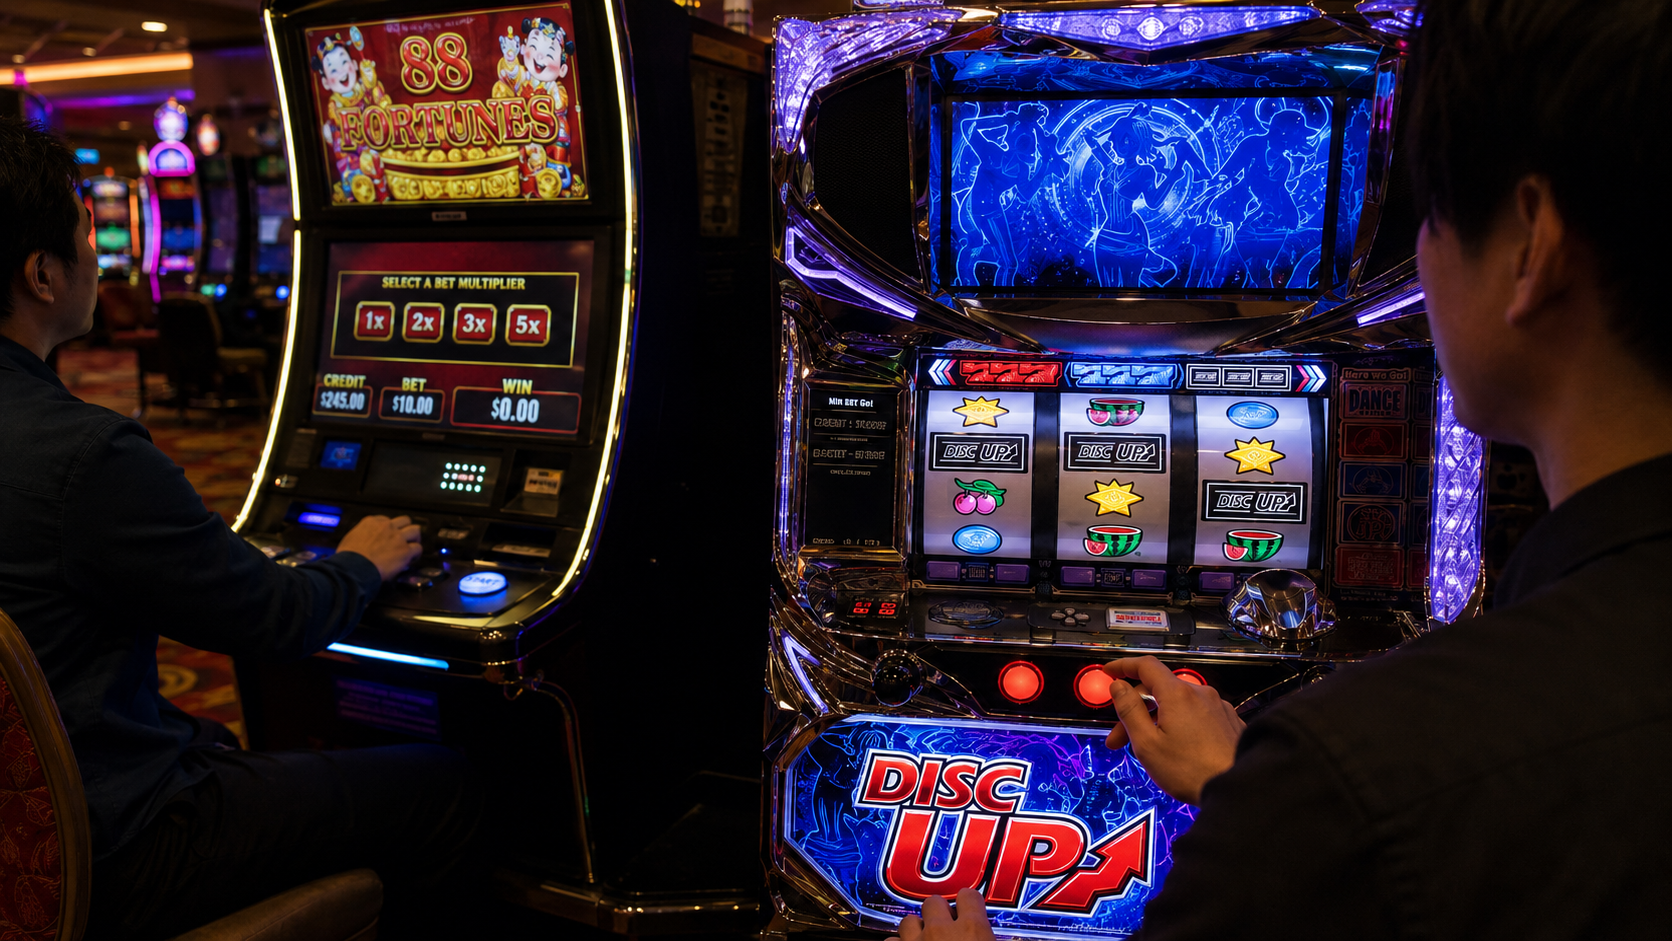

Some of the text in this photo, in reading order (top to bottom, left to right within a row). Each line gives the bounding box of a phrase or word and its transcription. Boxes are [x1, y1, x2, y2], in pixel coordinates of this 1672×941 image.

[400, 32, 473, 95] 88
[338, 94, 559, 151] FORTUNES
[382, 277, 526, 291] SELECT A BET MULTIPLIER
[365, 311, 385, 330] 1x
[411, 312, 435, 332] 2x
[462, 313, 486, 333] 3x
[515, 315, 540, 335] 5x
[324, 373, 367, 389] CREDIT
[401, 377, 427, 392] BET
[502, 378, 533, 395] WIN
[320, 390, 366, 411] $245.00
[392, 394, 434, 415] $10.00
[491, 397, 540, 423] $0.00
[1348, 388, 1402, 412] DANCE
[943, 443, 1013, 462] DISC UP
[1077, 443, 1150, 462] DISC UP
[1216, 492, 1290, 512] DISC UP
[856, 750, 1032, 813] DISC
[883, 808, 1092, 908] UP
